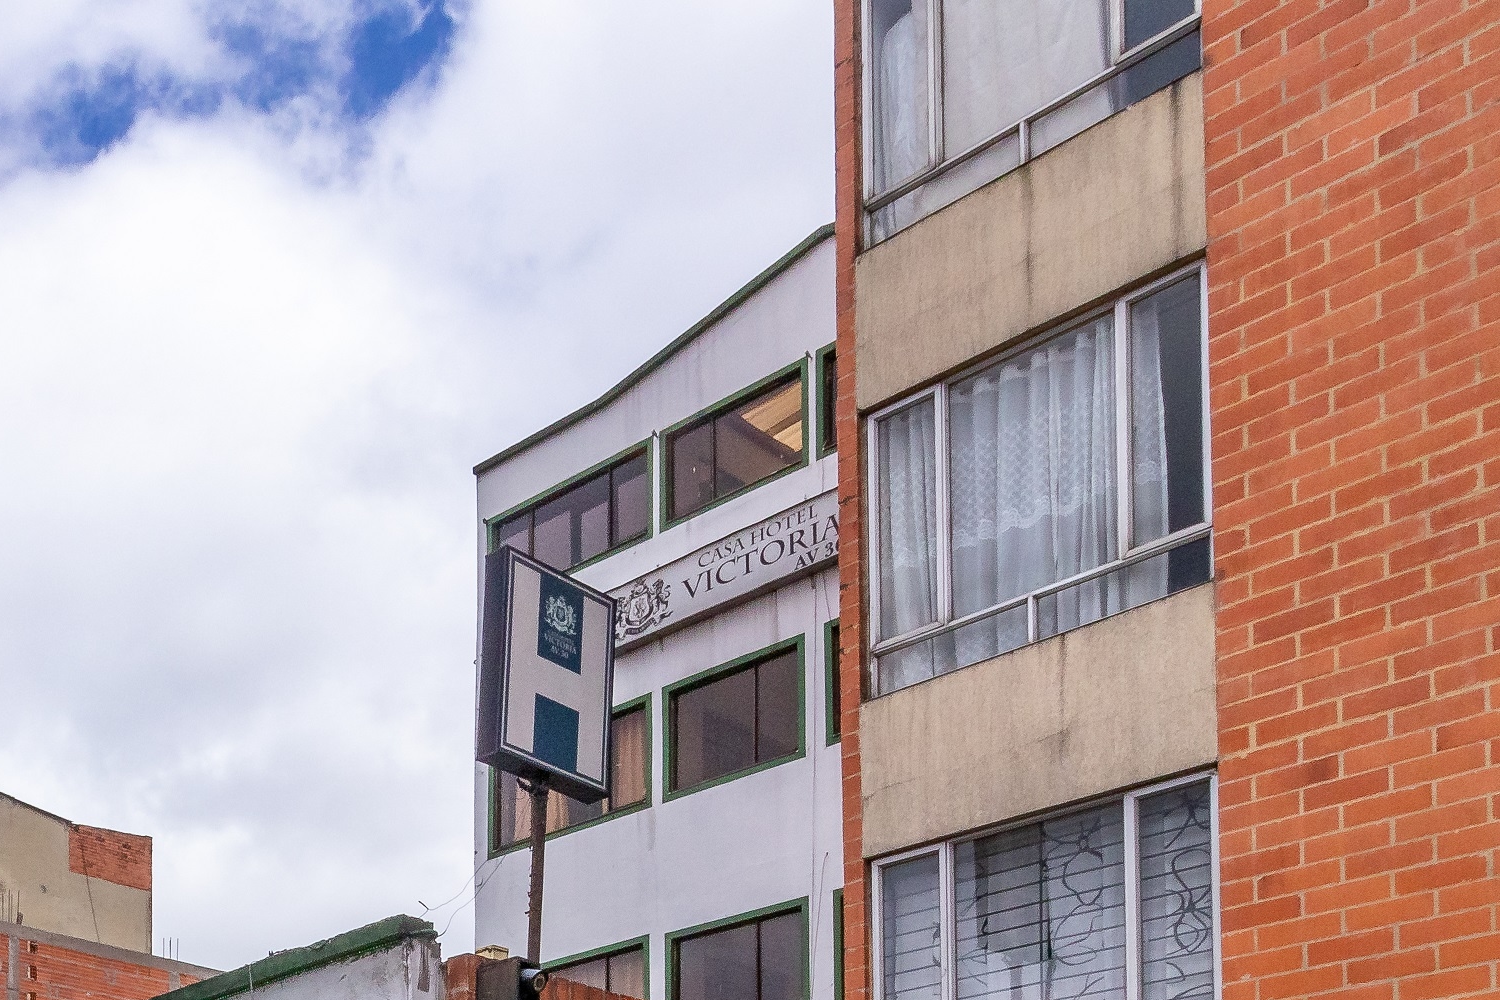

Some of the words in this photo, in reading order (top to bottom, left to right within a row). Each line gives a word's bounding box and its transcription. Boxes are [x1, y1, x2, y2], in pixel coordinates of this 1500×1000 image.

[681, 513, 838, 598] VICTORIA
[698, 538, 745, 568] CASA
[751, 504, 818, 545] HOTEL
[794, 547, 819, 571] AV
